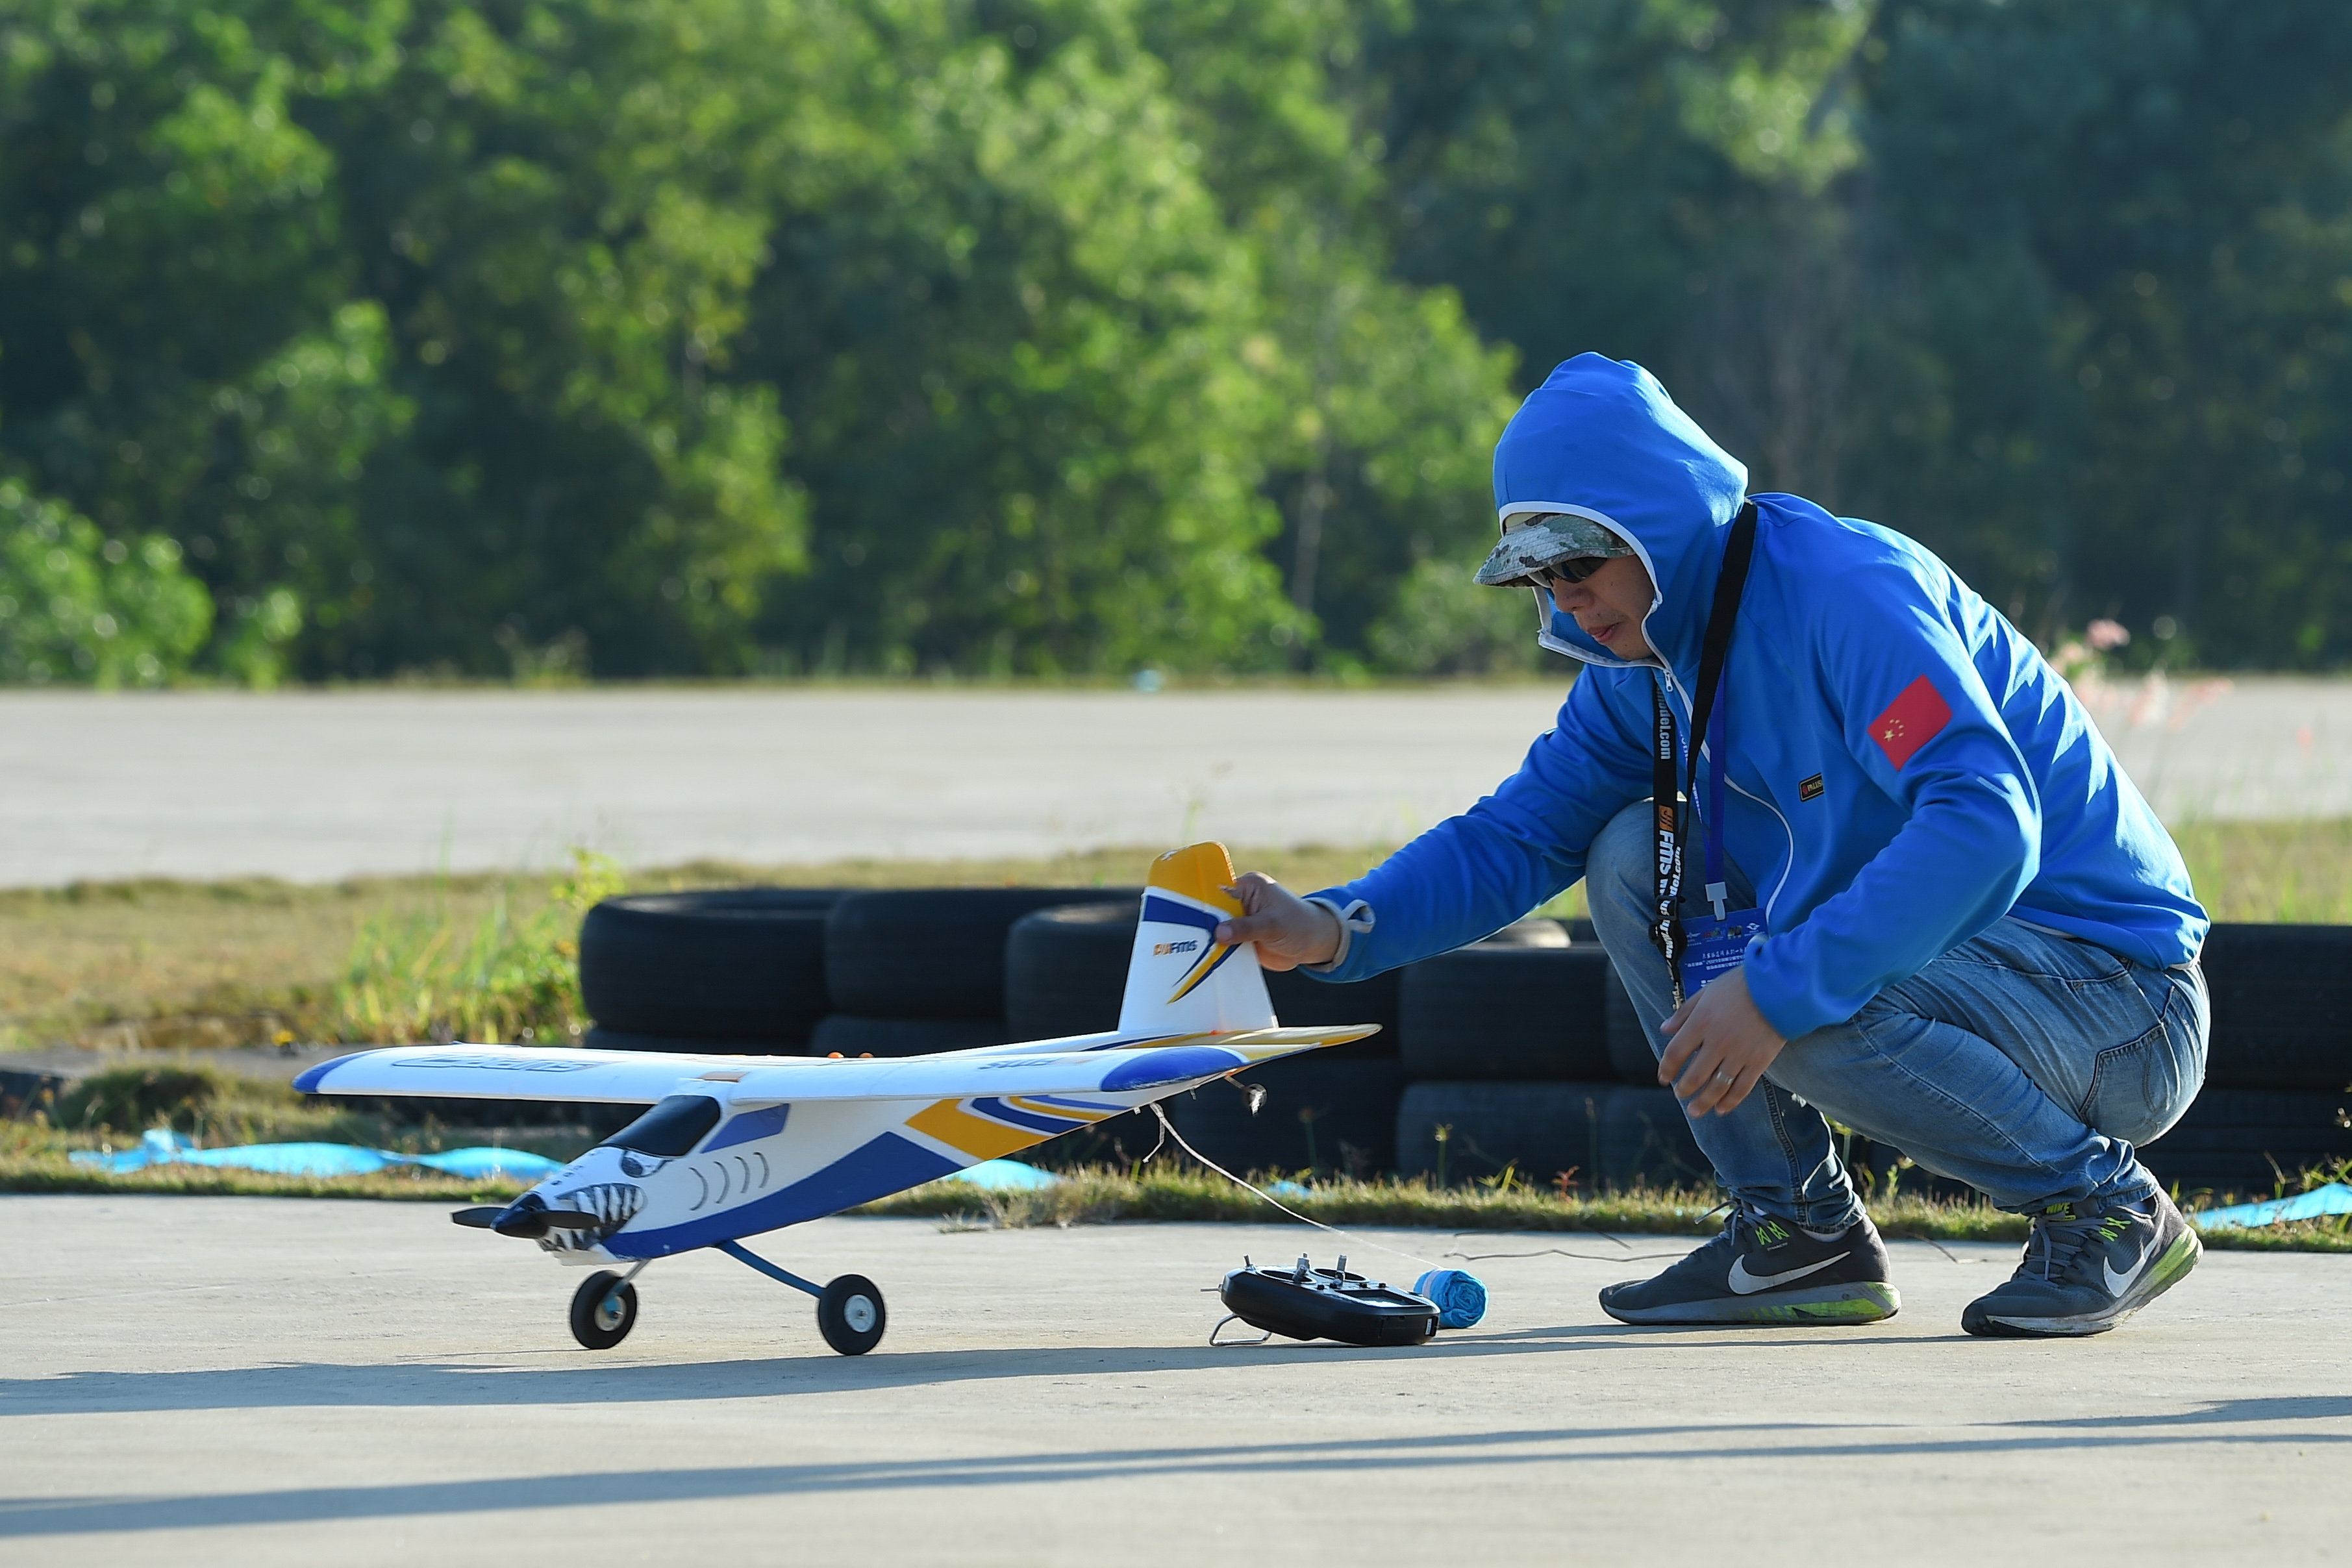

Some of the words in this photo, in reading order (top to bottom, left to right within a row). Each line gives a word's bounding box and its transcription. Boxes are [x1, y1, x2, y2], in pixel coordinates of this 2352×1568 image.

[1659, 830, 1674, 875] FMS
[1170, 939, 1198, 954] FMS
[2045, 1202, 2071, 1214] NIKE
